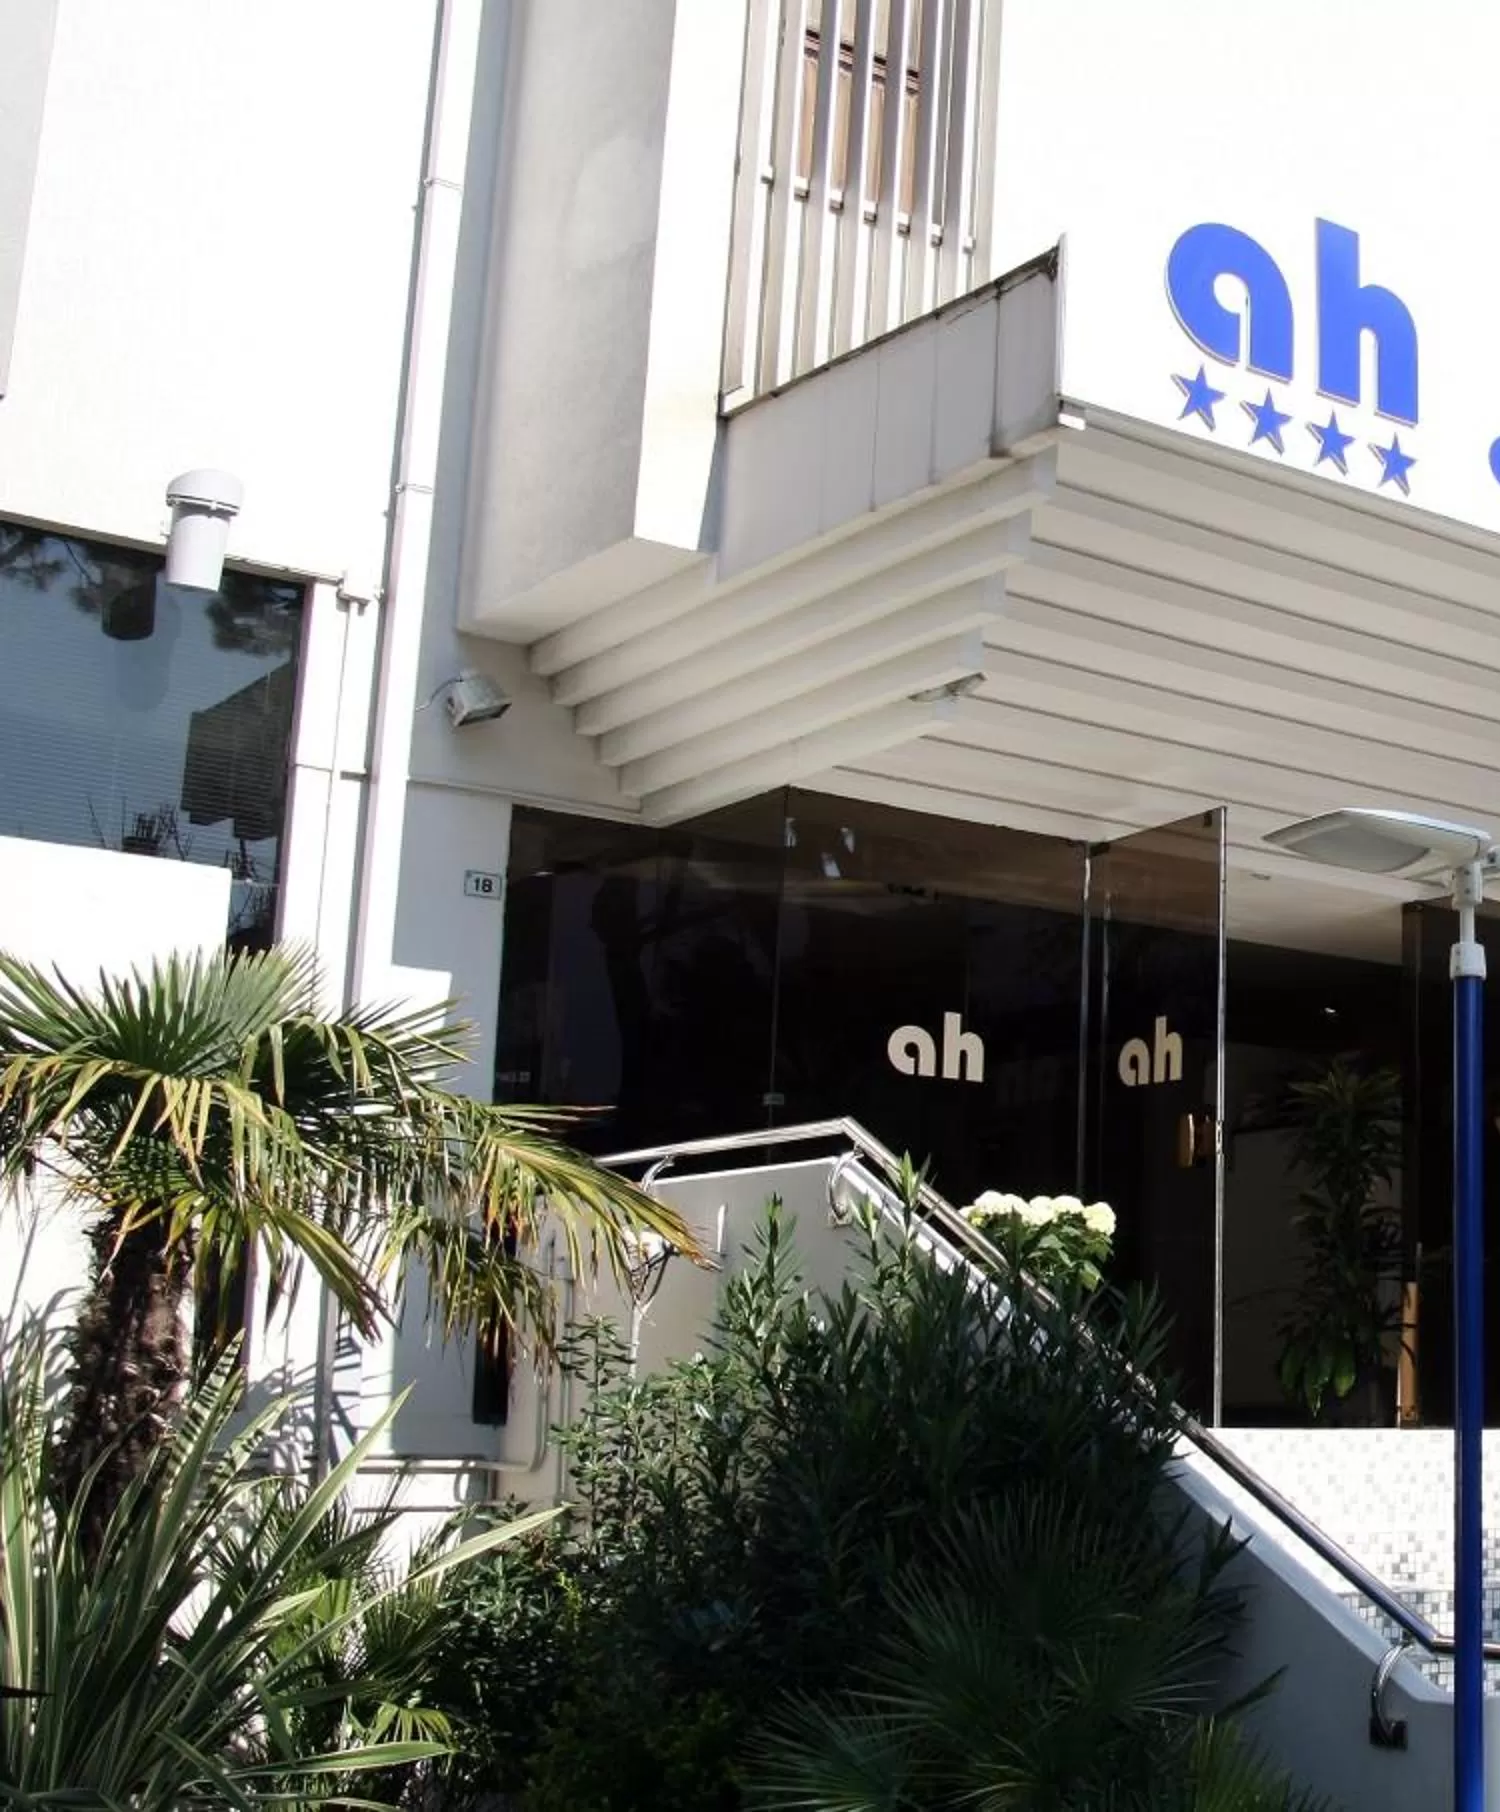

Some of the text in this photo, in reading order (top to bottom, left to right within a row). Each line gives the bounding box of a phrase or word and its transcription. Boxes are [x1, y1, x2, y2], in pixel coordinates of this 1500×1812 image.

[1166, 217, 1418, 427] ah
[474, 877, 493, 893] 18
[886, 1011, 985, 1083] ah
[1117, 1014, 1185, 1087] ah
